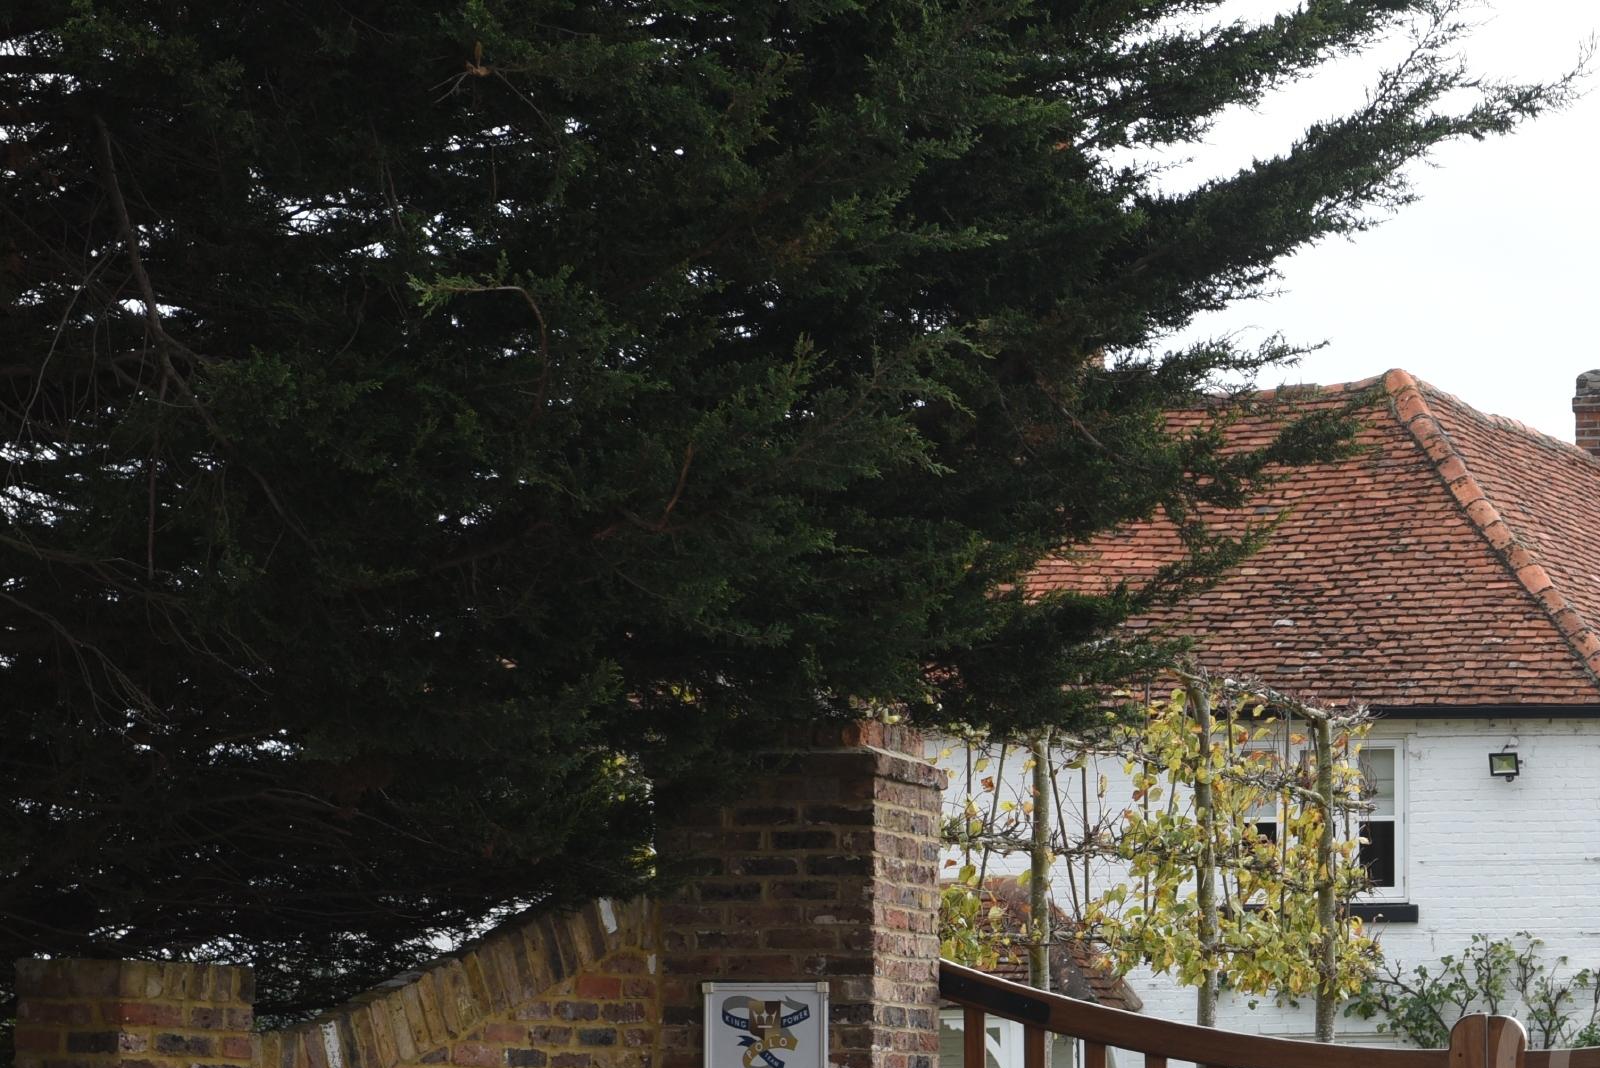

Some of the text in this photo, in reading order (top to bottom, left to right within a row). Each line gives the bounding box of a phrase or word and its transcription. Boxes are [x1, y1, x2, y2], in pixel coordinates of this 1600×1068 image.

[725, 1011, 809, 1028] KING POWER
[746, 1037, 788, 1059] POLO
[764, 1052, 780, 1068] TEAM
